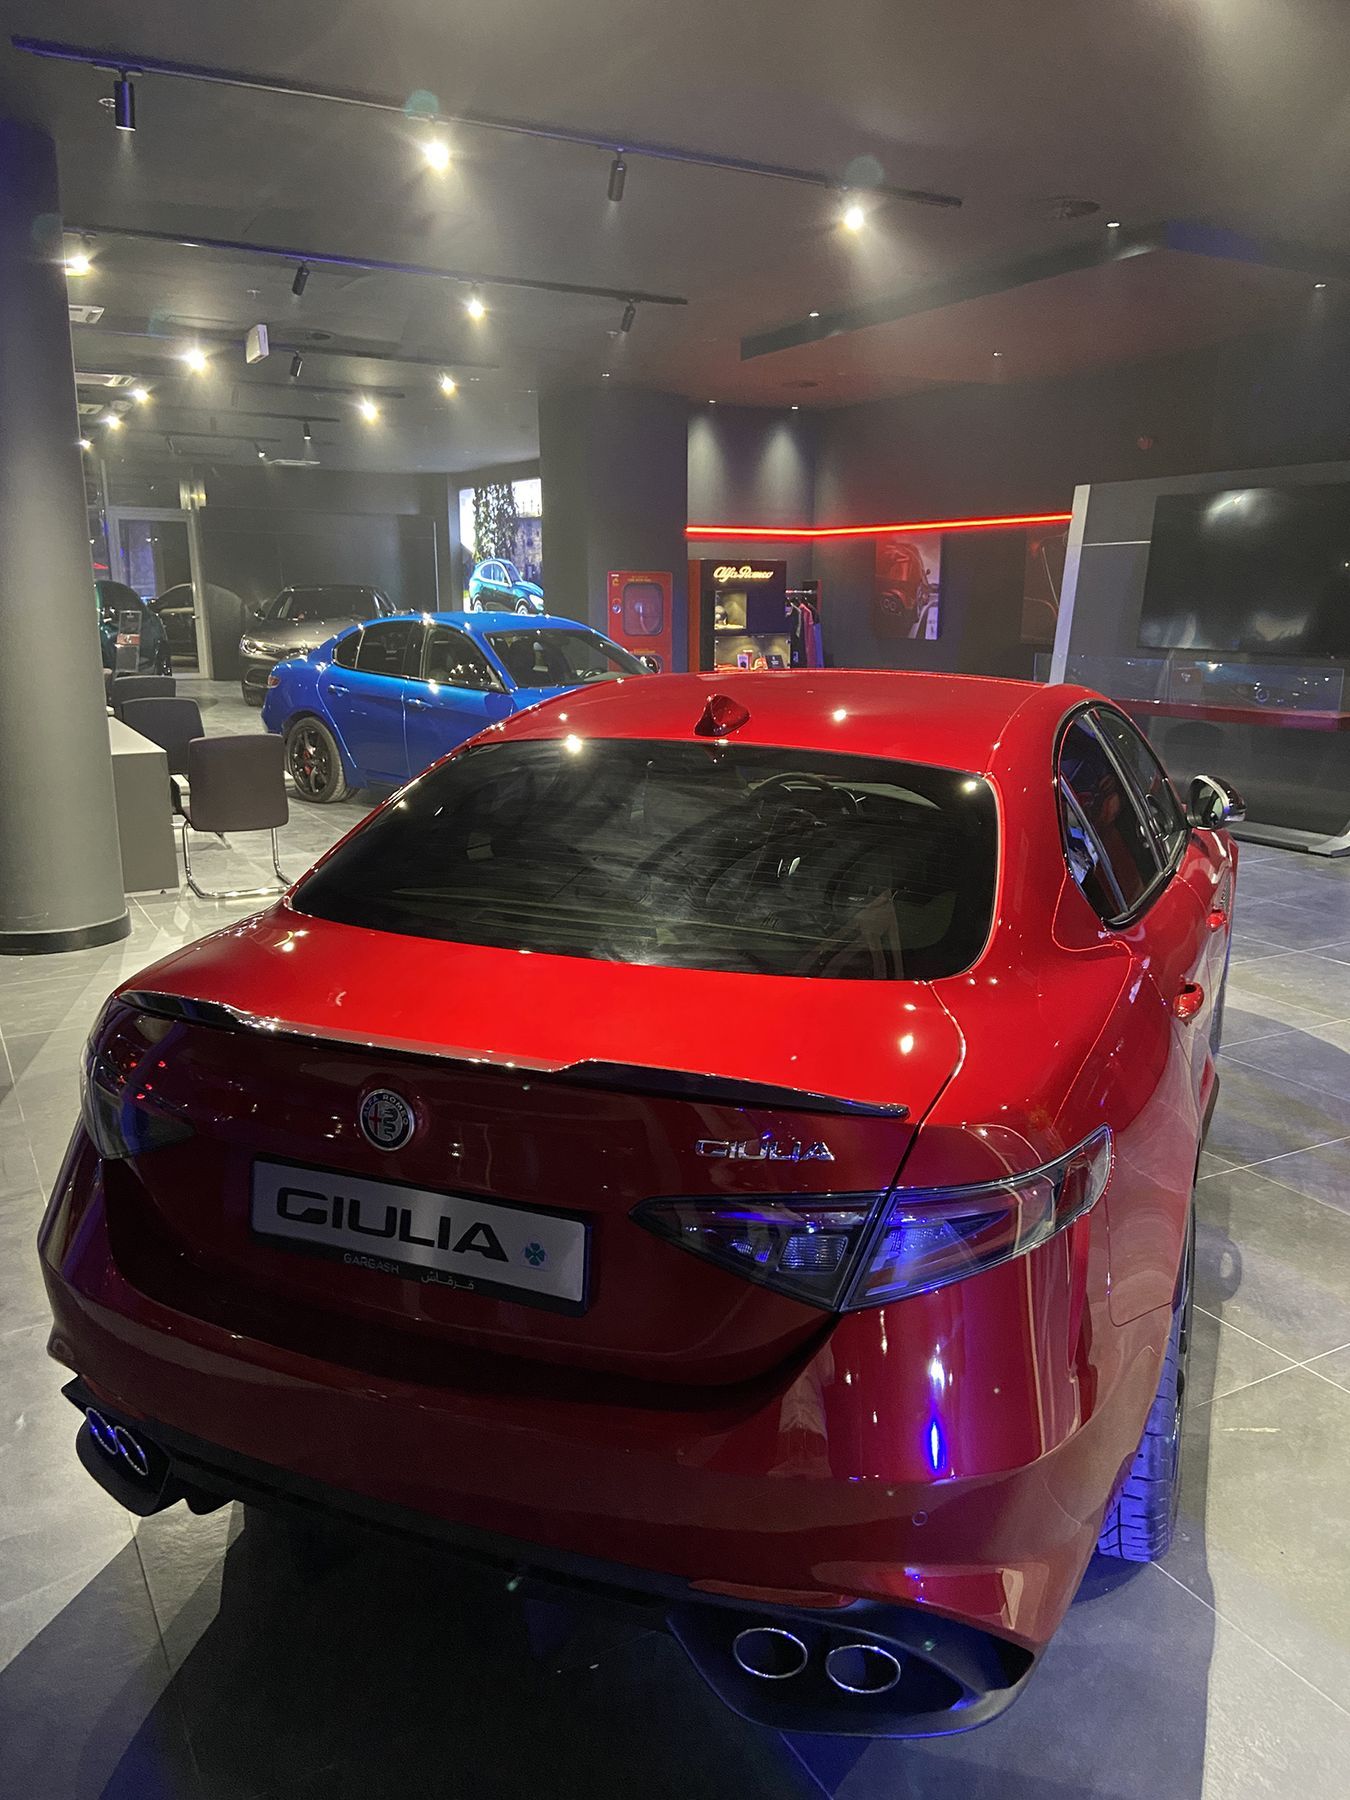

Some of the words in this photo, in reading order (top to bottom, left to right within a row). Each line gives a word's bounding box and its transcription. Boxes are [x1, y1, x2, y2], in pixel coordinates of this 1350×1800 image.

[713, 566, 738, 582] Alfa
[739, 565, 774, 579] Romeo
[363, 1095, 379, 1117] ALFA
[382, 1094, 409, 1126] ROMEO
[695, 1139, 835, 1162] GIULIA
[276, 1186, 510, 1263] GIULIA
